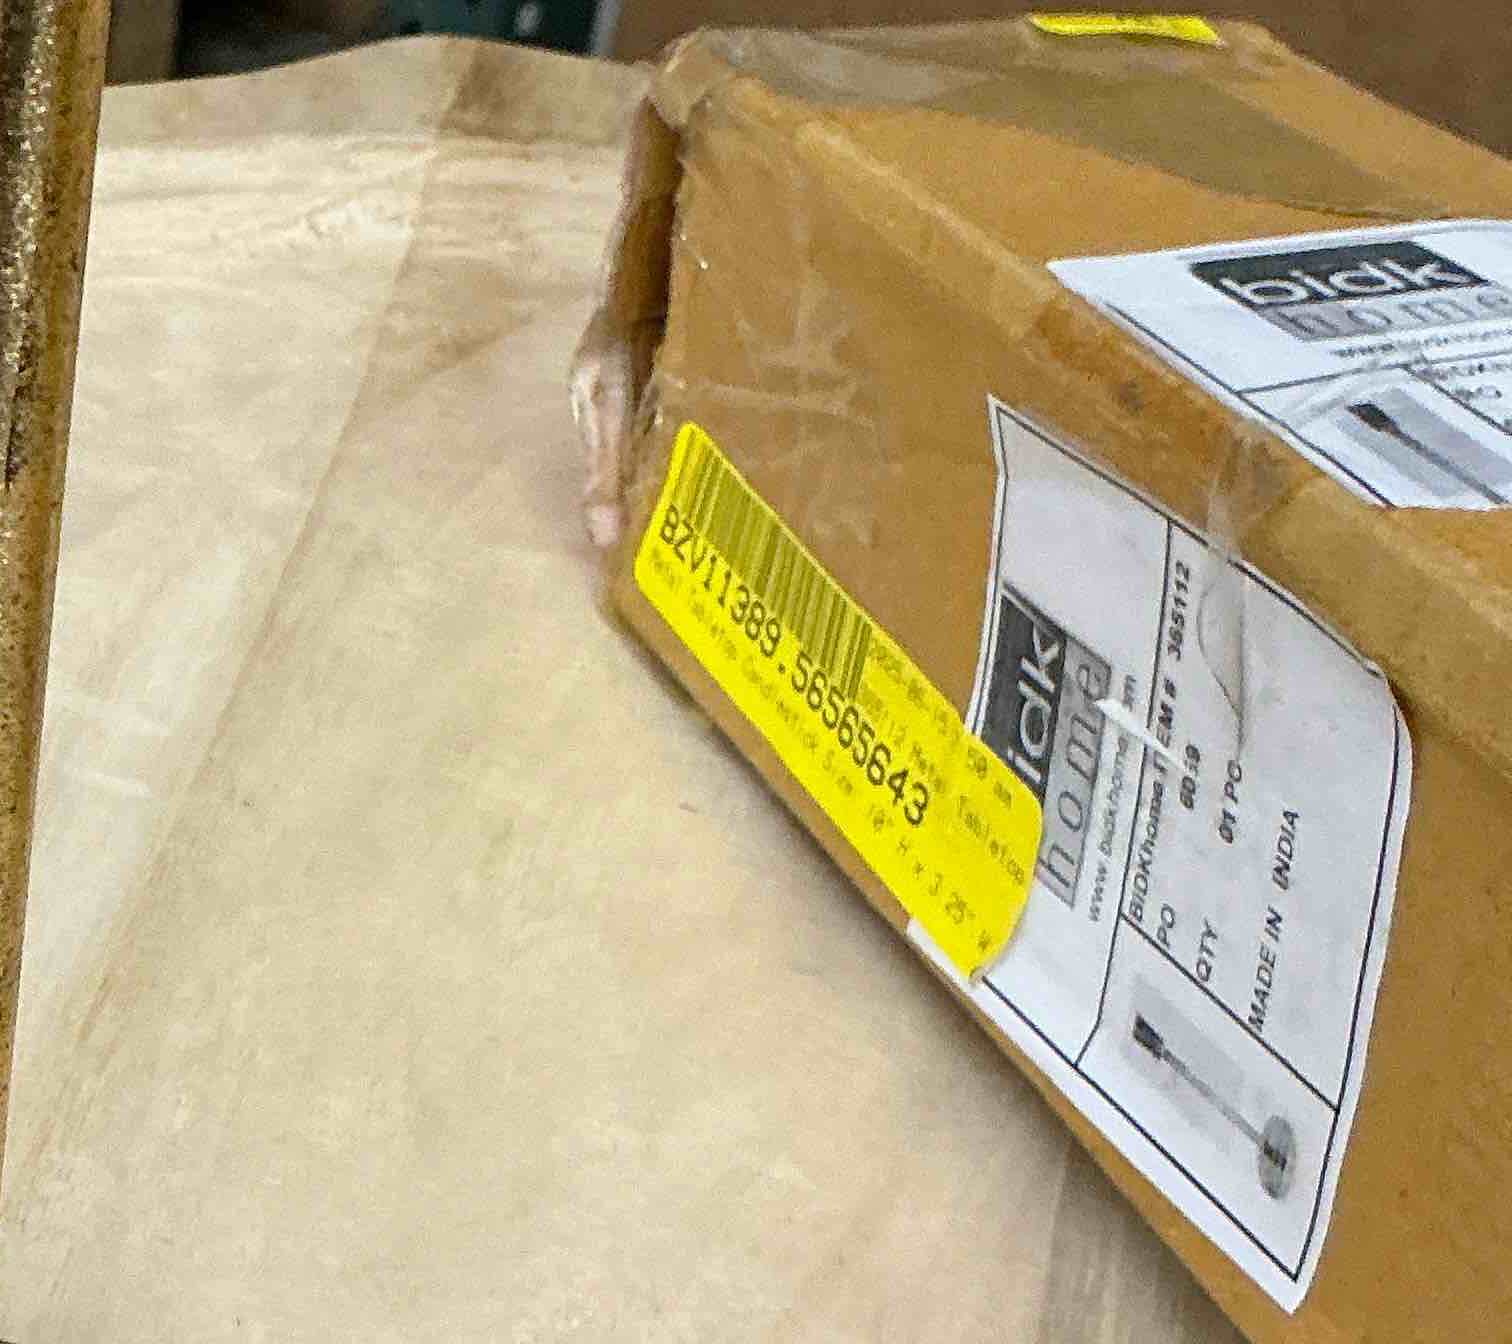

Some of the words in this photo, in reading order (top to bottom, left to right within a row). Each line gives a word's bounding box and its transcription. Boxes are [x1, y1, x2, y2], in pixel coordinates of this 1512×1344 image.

[1167, 559, 1190, 661] 365112
[1007, 619, 1063, 783] idk
[1038, 660, 1110, 889] home
[1272, 809, 1300, 890] INDIA
[1156, 903, 1176, 948] PO
[1195, 918, 1218, 982] QTY
[1263, 905, 1283, 942] IN
[1247, 942, 1276, 1032] MADE
